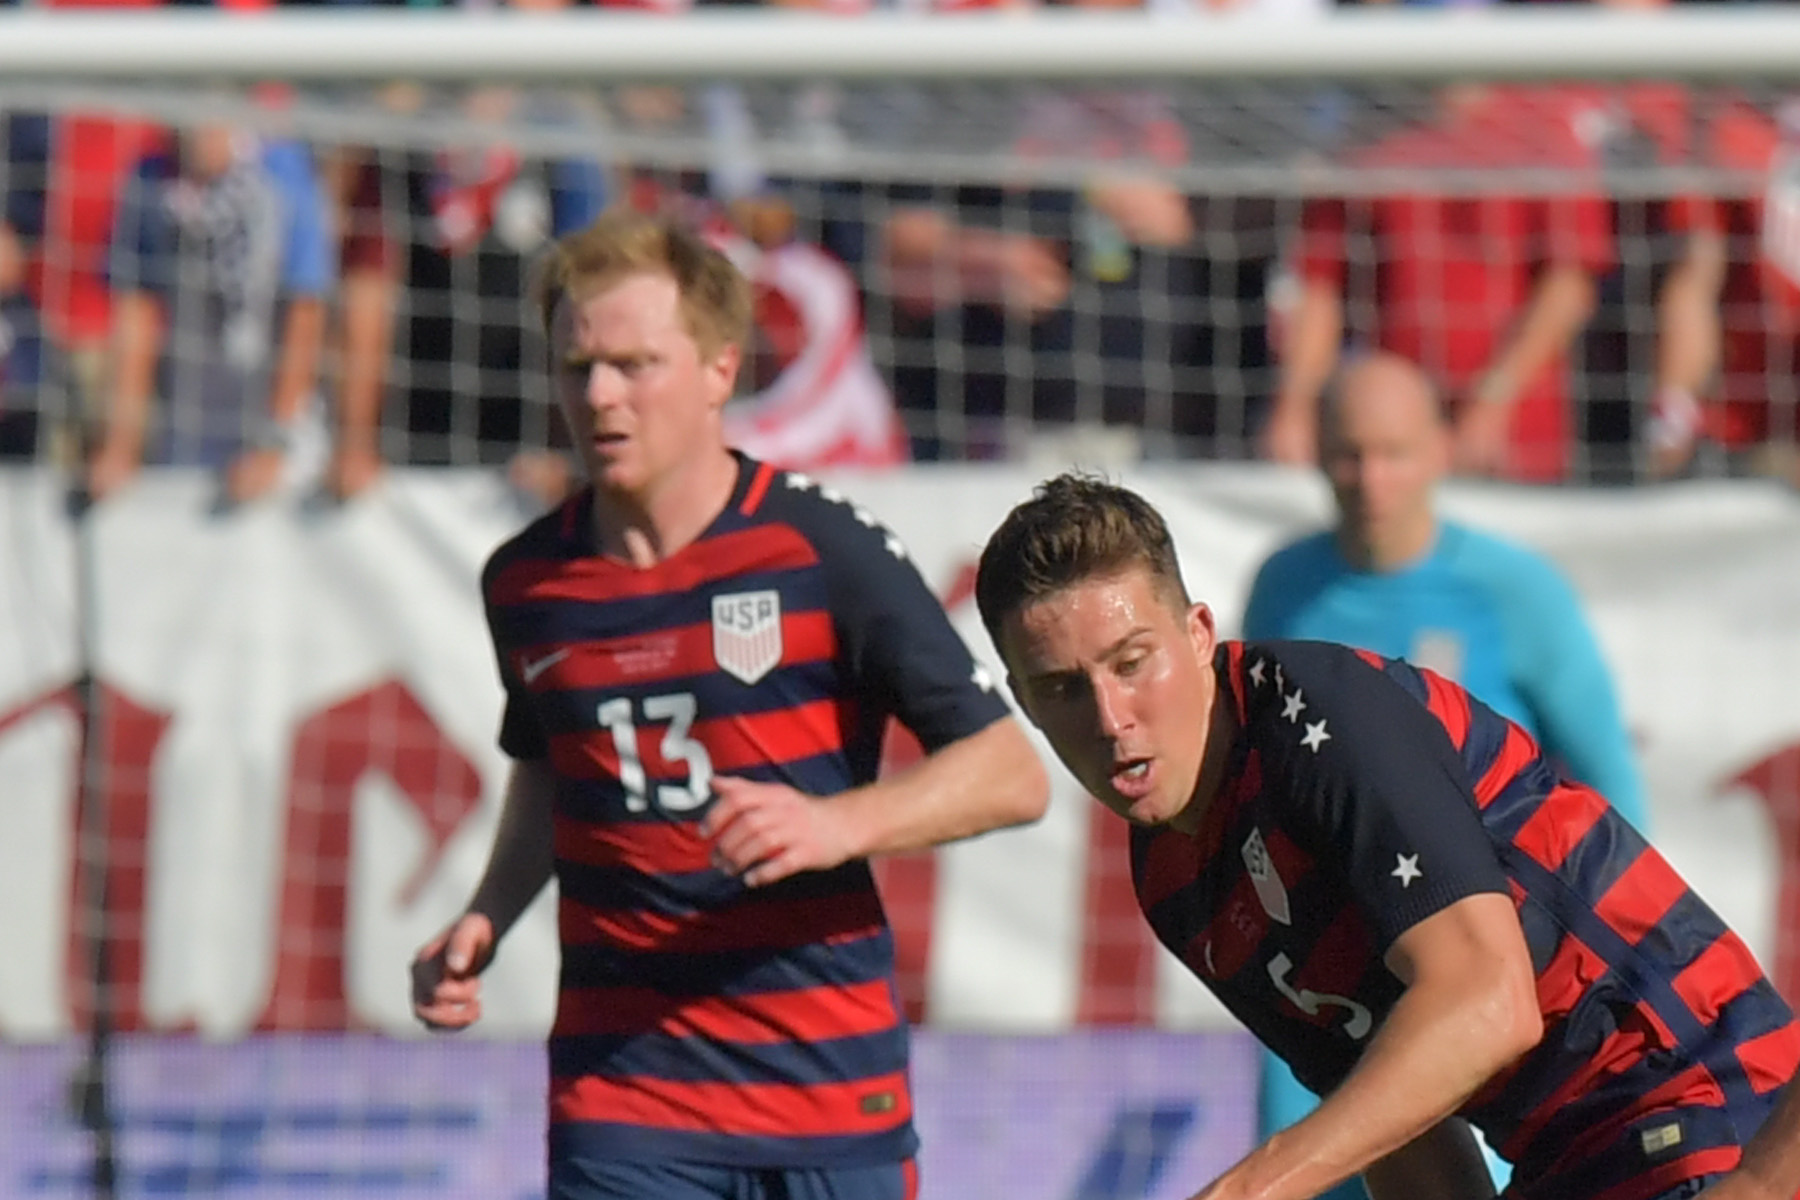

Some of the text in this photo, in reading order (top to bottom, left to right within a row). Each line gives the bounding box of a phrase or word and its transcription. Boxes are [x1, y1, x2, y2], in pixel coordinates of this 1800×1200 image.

[717, 599, 773, 630] USA
[597, 692, 714, 812] 13
[1266, 952, 1372, 1039] 5
